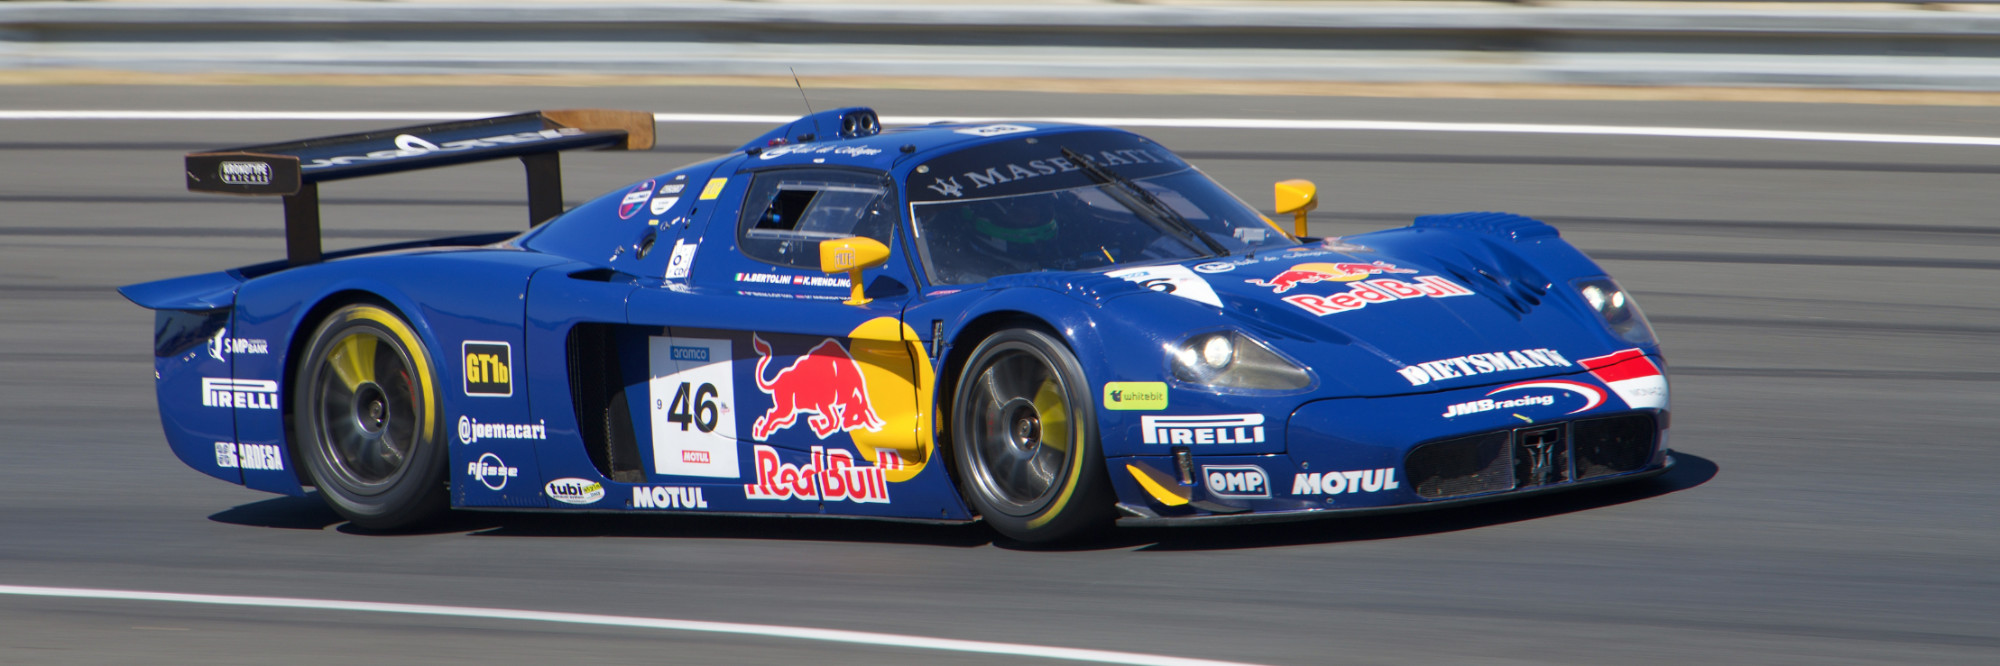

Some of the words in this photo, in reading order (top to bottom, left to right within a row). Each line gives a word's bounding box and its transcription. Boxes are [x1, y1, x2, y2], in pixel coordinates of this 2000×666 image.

[743, 273, 792, 284] A.BERTOLINI
[1281, 281, 1398, 316] Red
[1364, 275, 1475, 299] Bull
[466, 353, 509, 384] GT1b
[673, 348, 707, 360] aramco
[1397, 348, 1572, 386] DIETSMANN
[202, 377, 278, 409] PIRELLI
[656, 398, 663, 410] 9
[667, 382, 718, 433] 46
[1123, 392, 1163, 401] whitebit
[457, 415, 547, 445] @joemacari
[1141, 413, 1265, 444] PIRELLI
[683, 452, 710, 463] MOTUL
[550, 482, 583, 496] tubi
[744, 445, 822, 501] Red
[818, 447, 905, 504] Bull
[1291, 467, 1400, 495] MOTUL
[632, 486, 708, 508] MOTUL
